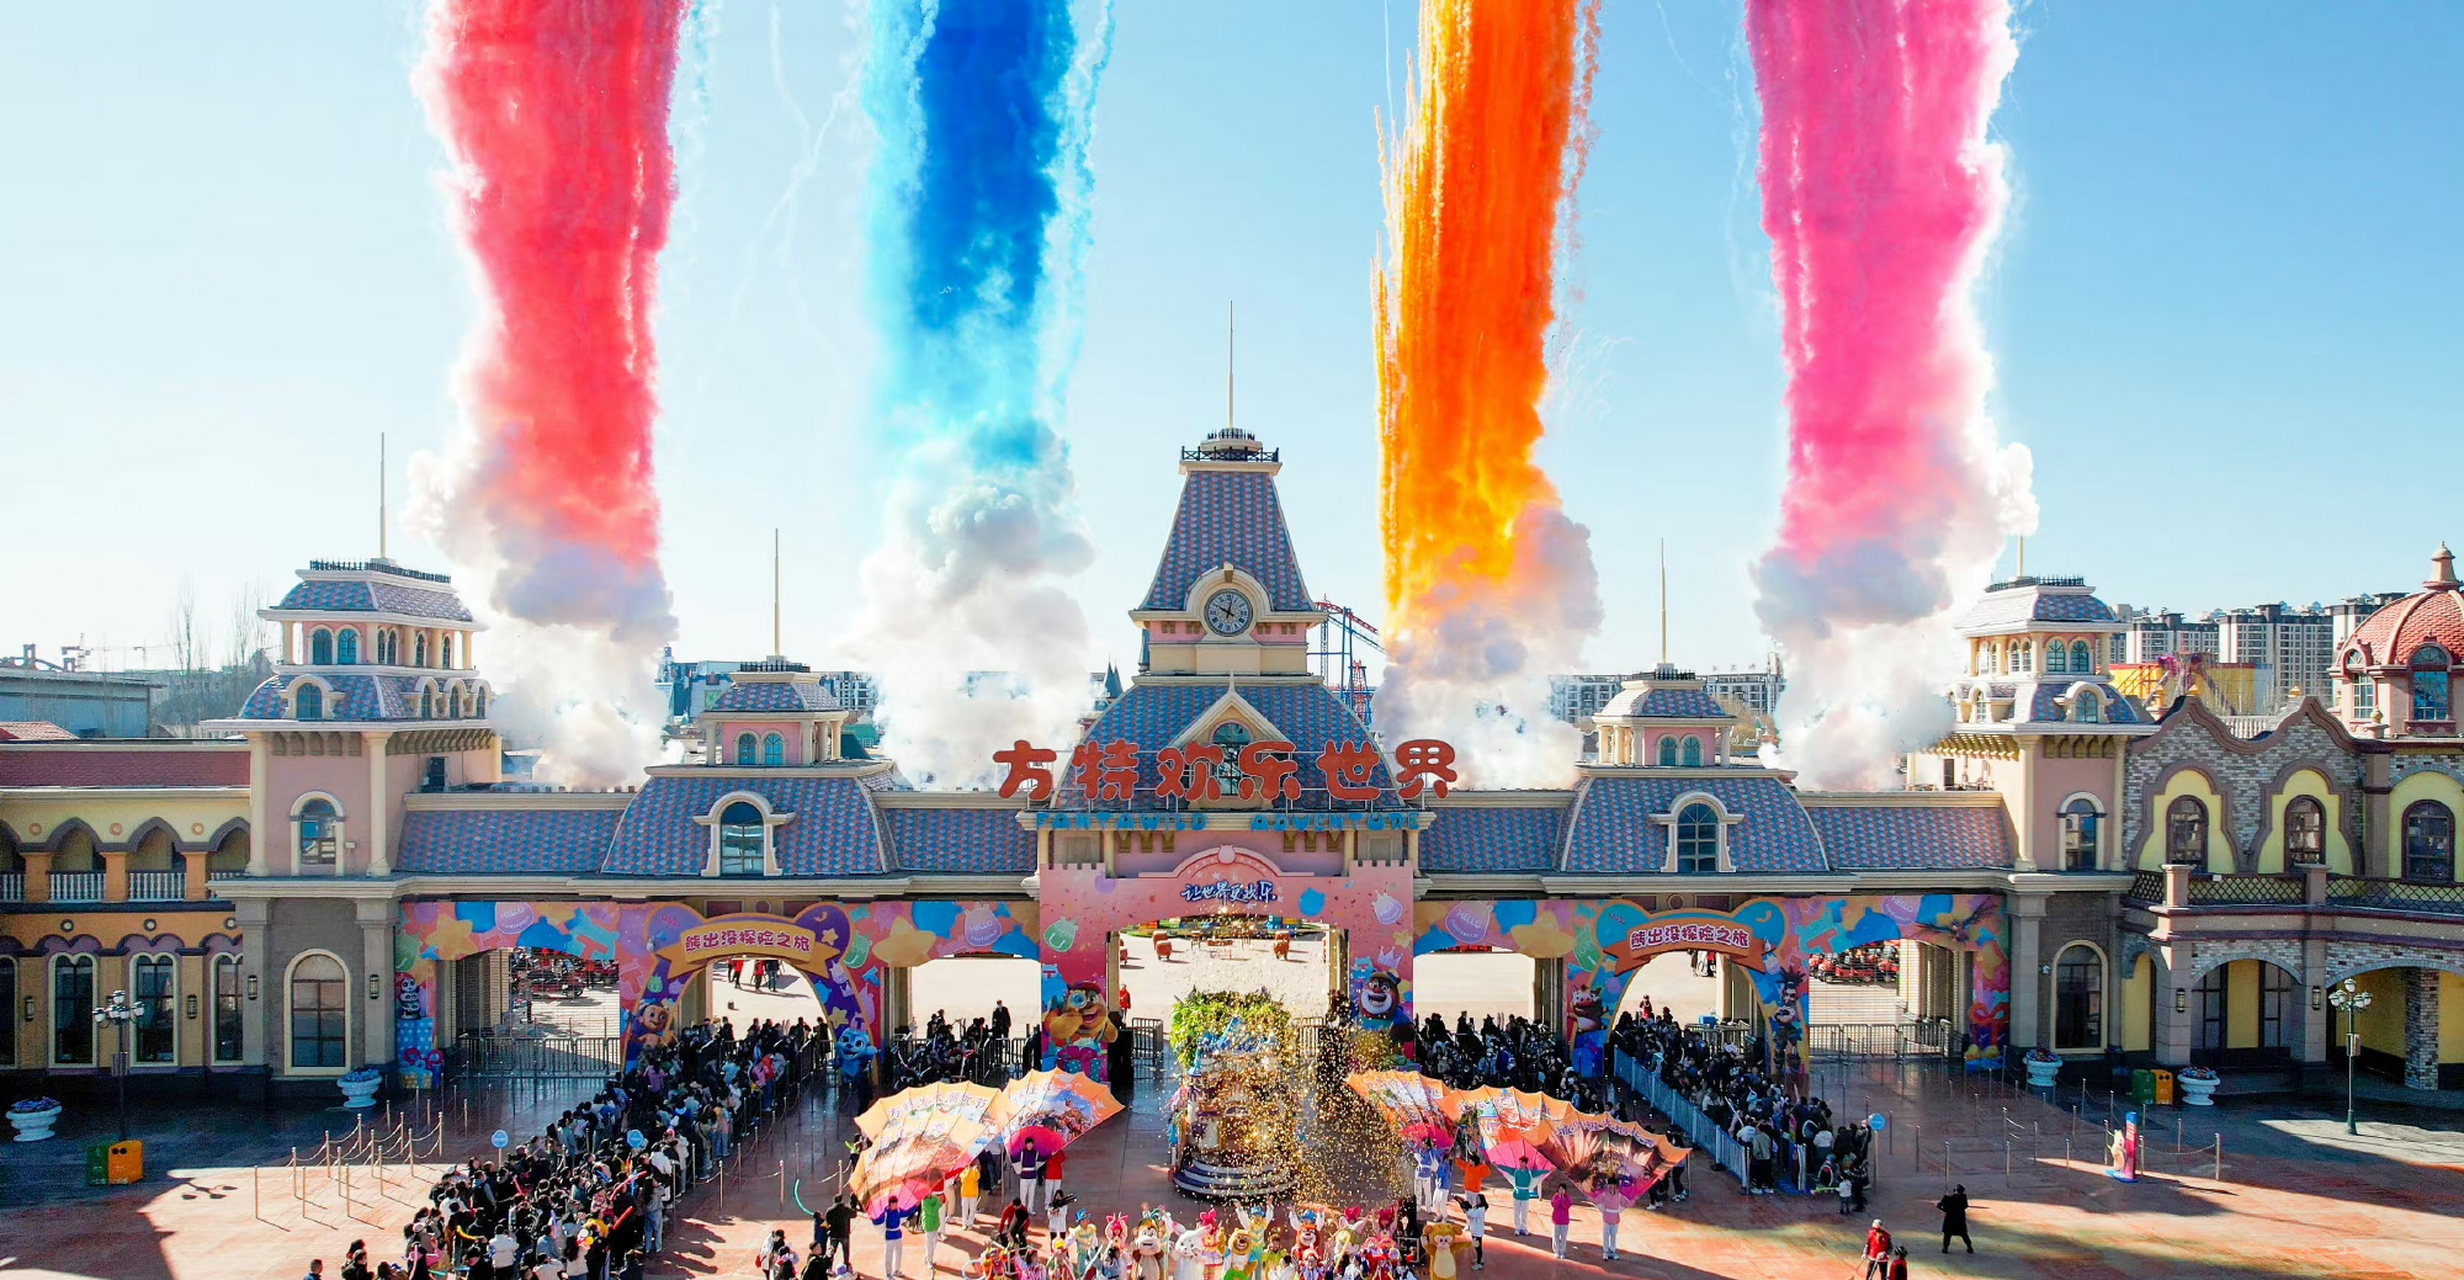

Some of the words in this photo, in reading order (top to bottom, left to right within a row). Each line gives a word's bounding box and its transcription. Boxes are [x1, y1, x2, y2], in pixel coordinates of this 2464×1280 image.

[993, 738, 1458, 800] 方特欢乐世界
[1036, 812, 1207, 831] FANTAWILD
[1251, 812, 1419, 832] ADVENTURE
[1180, 881, 1278, 905] 让世界更欢乐
[969, 920, 993, 932] HELLO
[1457, 910, 1481, 929] HELLO
[685, 929, 812, 953] 熊出没探险之旅
[1629, 925, 1750, 949] 熊出没探险之旅
